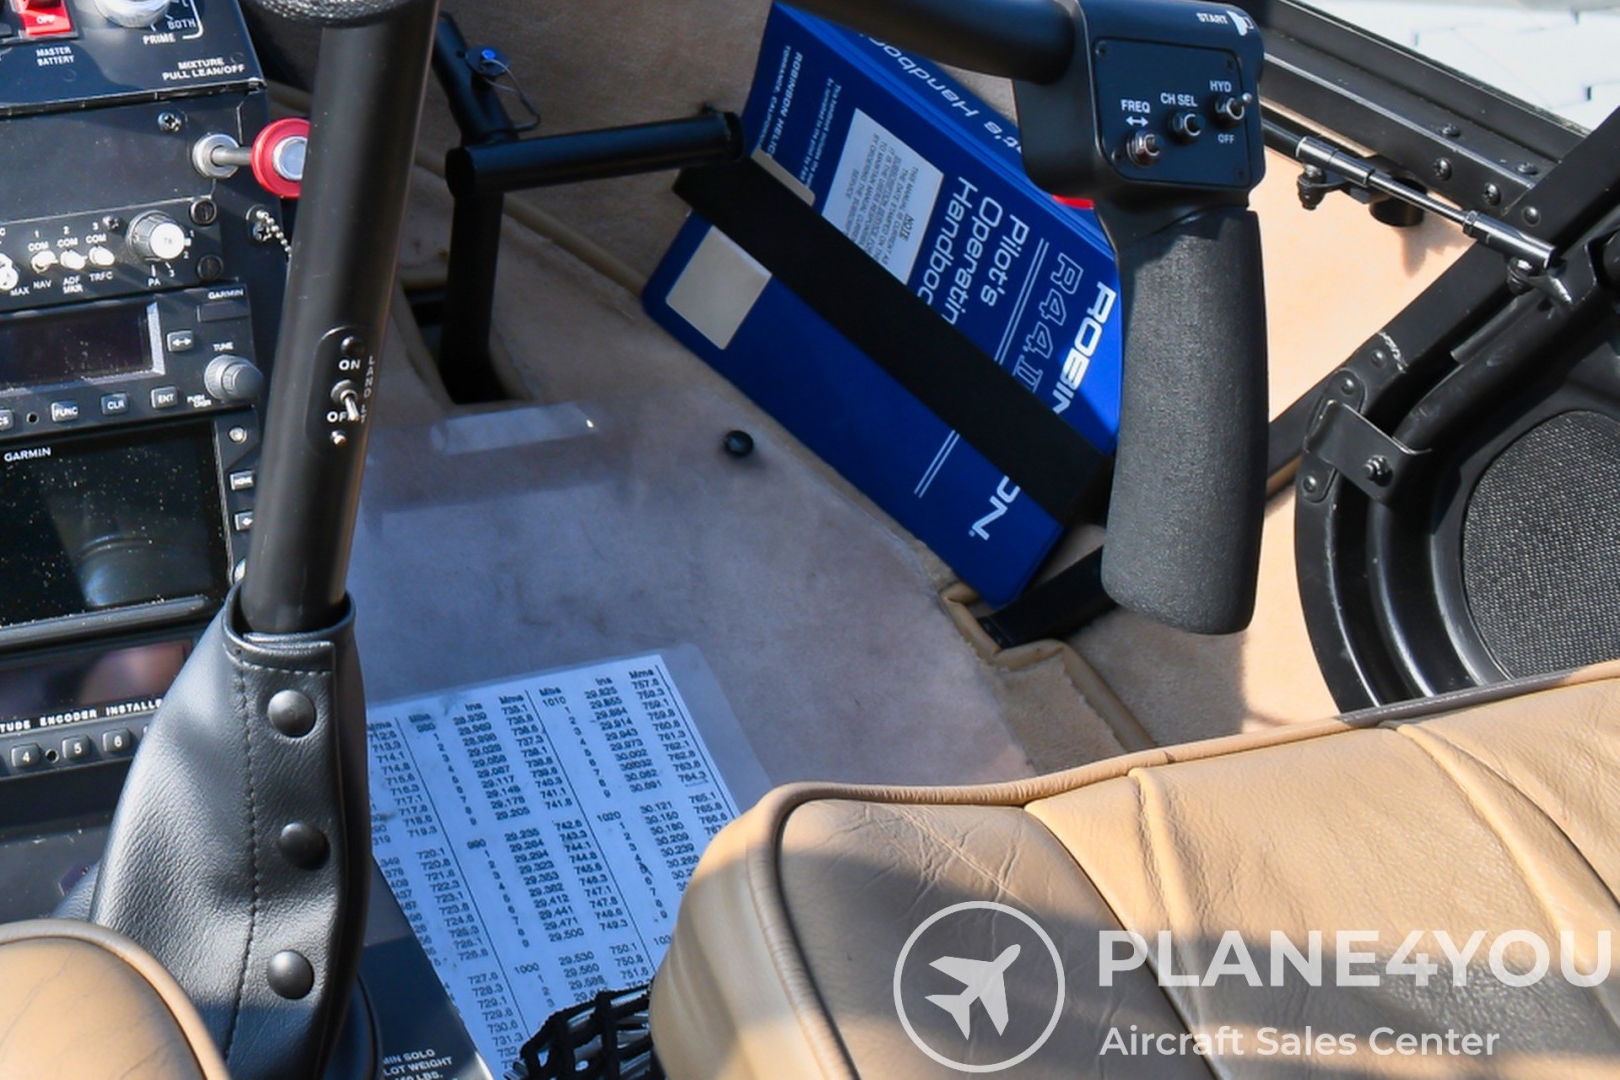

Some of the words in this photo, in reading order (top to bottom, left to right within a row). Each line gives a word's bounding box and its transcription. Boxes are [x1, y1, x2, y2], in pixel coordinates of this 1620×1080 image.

[167, 19, 196, 29] BOTH
[1196, 13, 1228, 24] START
[143, 34, 176, 44] PRIME
[36, 47, 71, 57] MASTER
[37, 55, 74, 65] BATTERY
[178, 57, 224, 69] MIXTURE
[162, 70, 190, 80] PULL
[1210, 81, 1232, 92] HYD
[1160, 92, 1175, 104] CH
[1177, 94, 1198, 108] SEL
[1121, 99, 1150, 113] FREQ
[1218, 134, 1234, 143] OFF
[942, 196, 1003, 325] Operatin
[981, 214, 1030, 307] Pilot's
[90, 272, 113, 282] TRFC
[148, 278, 161, 286] PA
[33, 280, 52, 289] NAV
[208, 289, 244, 300] GARMIN
[1026, 253, 1083, 359] R44
[214, 342, 234, 350] TUNE
[339, 359, 360, 370] ON
[108, 400, 124, 410] CLR
[56, 406, 78, 417] FUNC
[4, 448, 51, 460] GARMIN
[40, 710, 97, 726] ENCODER
[22, 752, 30, 763] 4
[597, 812, 621, 822] 1020
[403, 1049, 435, 1062] SOLO
[408, 1057, 453, 1072] WEIGHT
